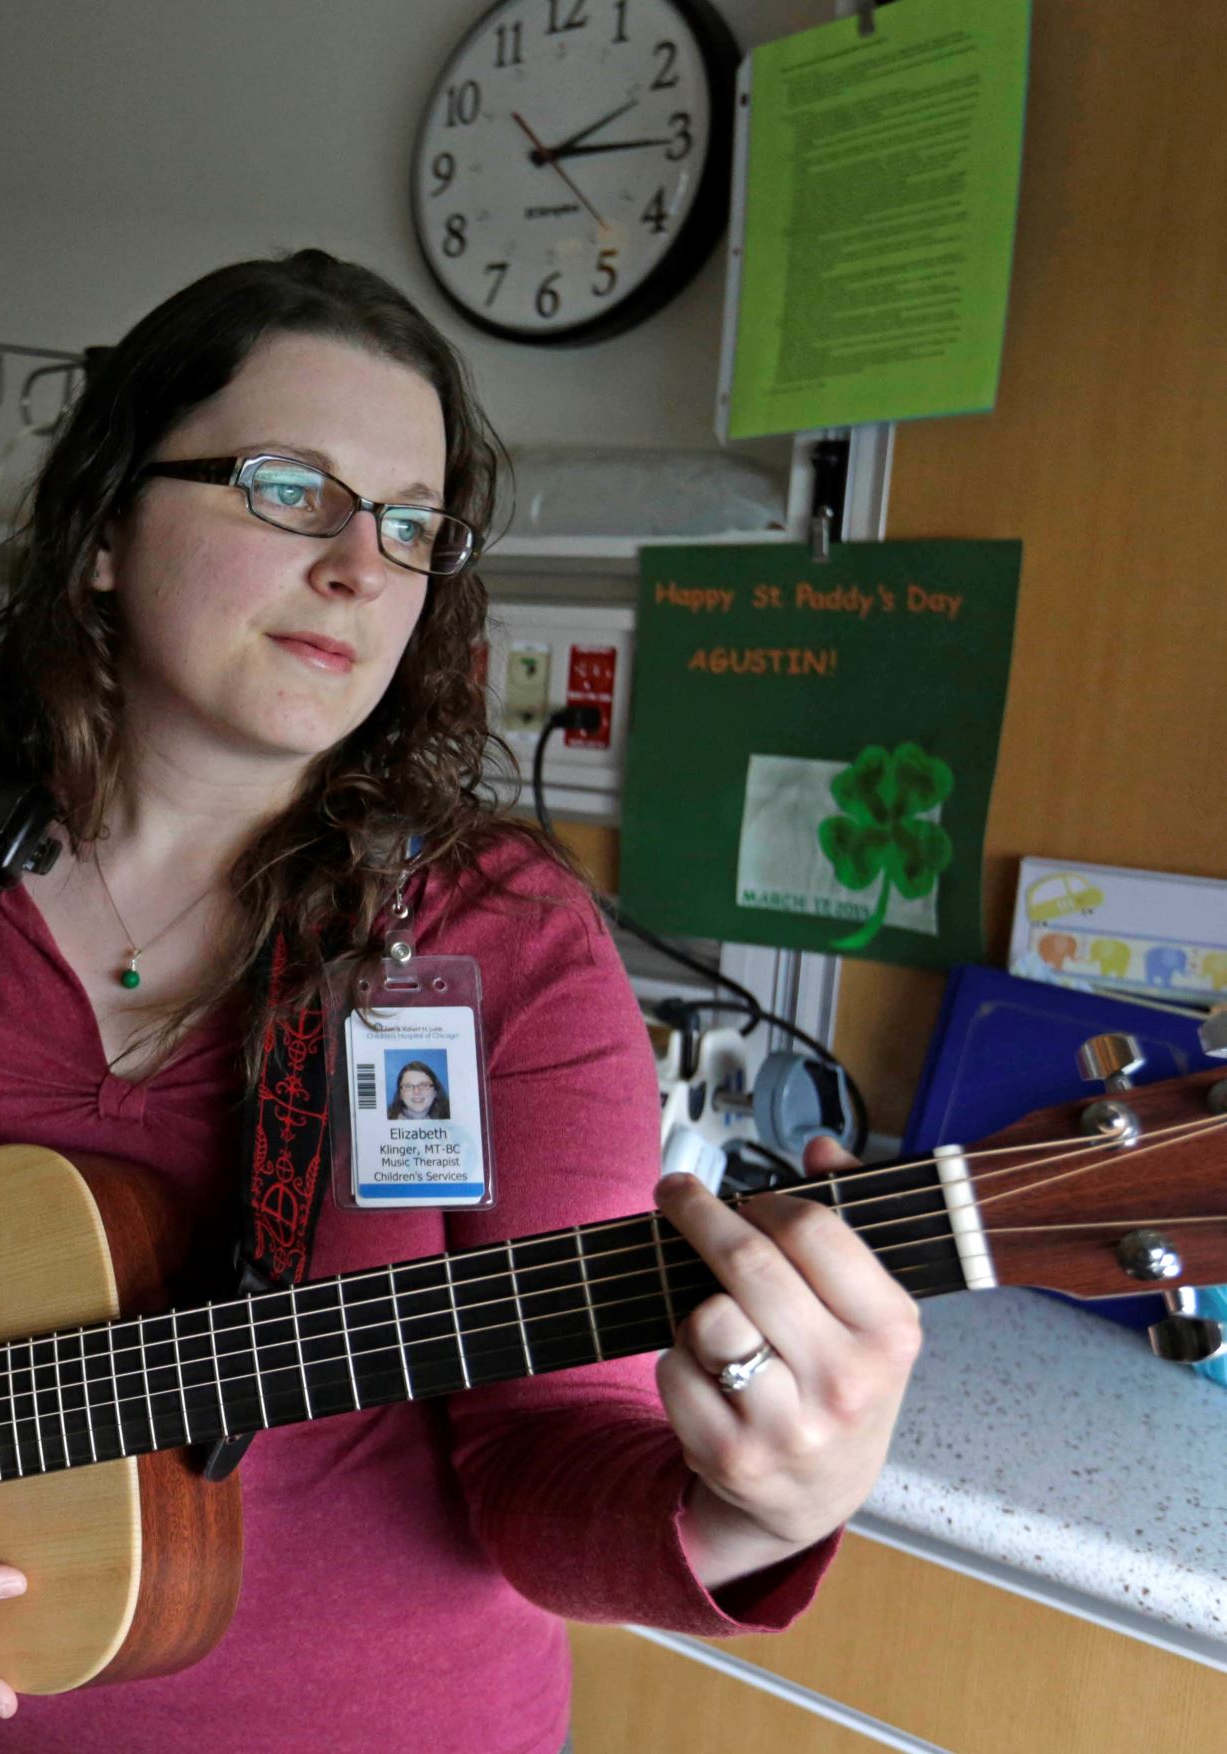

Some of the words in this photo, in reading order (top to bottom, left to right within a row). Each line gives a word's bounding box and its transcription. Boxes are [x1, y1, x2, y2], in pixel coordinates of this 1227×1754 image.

[544, 0, 588, 35] 12
[611, 0, 630, 44] 1
[494, 21, 524, 68] 11
[650, 41, 678, 91] 2
[444, 80, 481, 128] 10
[665, 112, 693, 162] 3
[431, 153, 456, 198] 9
[642, 187, 669, 235] 4
[442, 213, 468, 258] 8
[484, 262, 511, 308] 7
[535, 271, 564, 318] 6
[592, 250, 618, 297] 5
[655, 581, 734, 613] Happy
[795, 581, 895, 619] Paddy's
[906, 584, 965, 620] Day
[688, 646, 838, 676] AGUSTIN!
[380, 1144, 420, 1156] Klinger,
[425, 1144, 460, 1154] MT-BC
[390, 1127, 447, 1140] Elizabeth
[374, 1171, 423, 1182] Children's
[426, 1171, 468, 1181] Services
[382, 1157, 410, 1167] Music
[414, 1157, 460, 1168] Therapist
